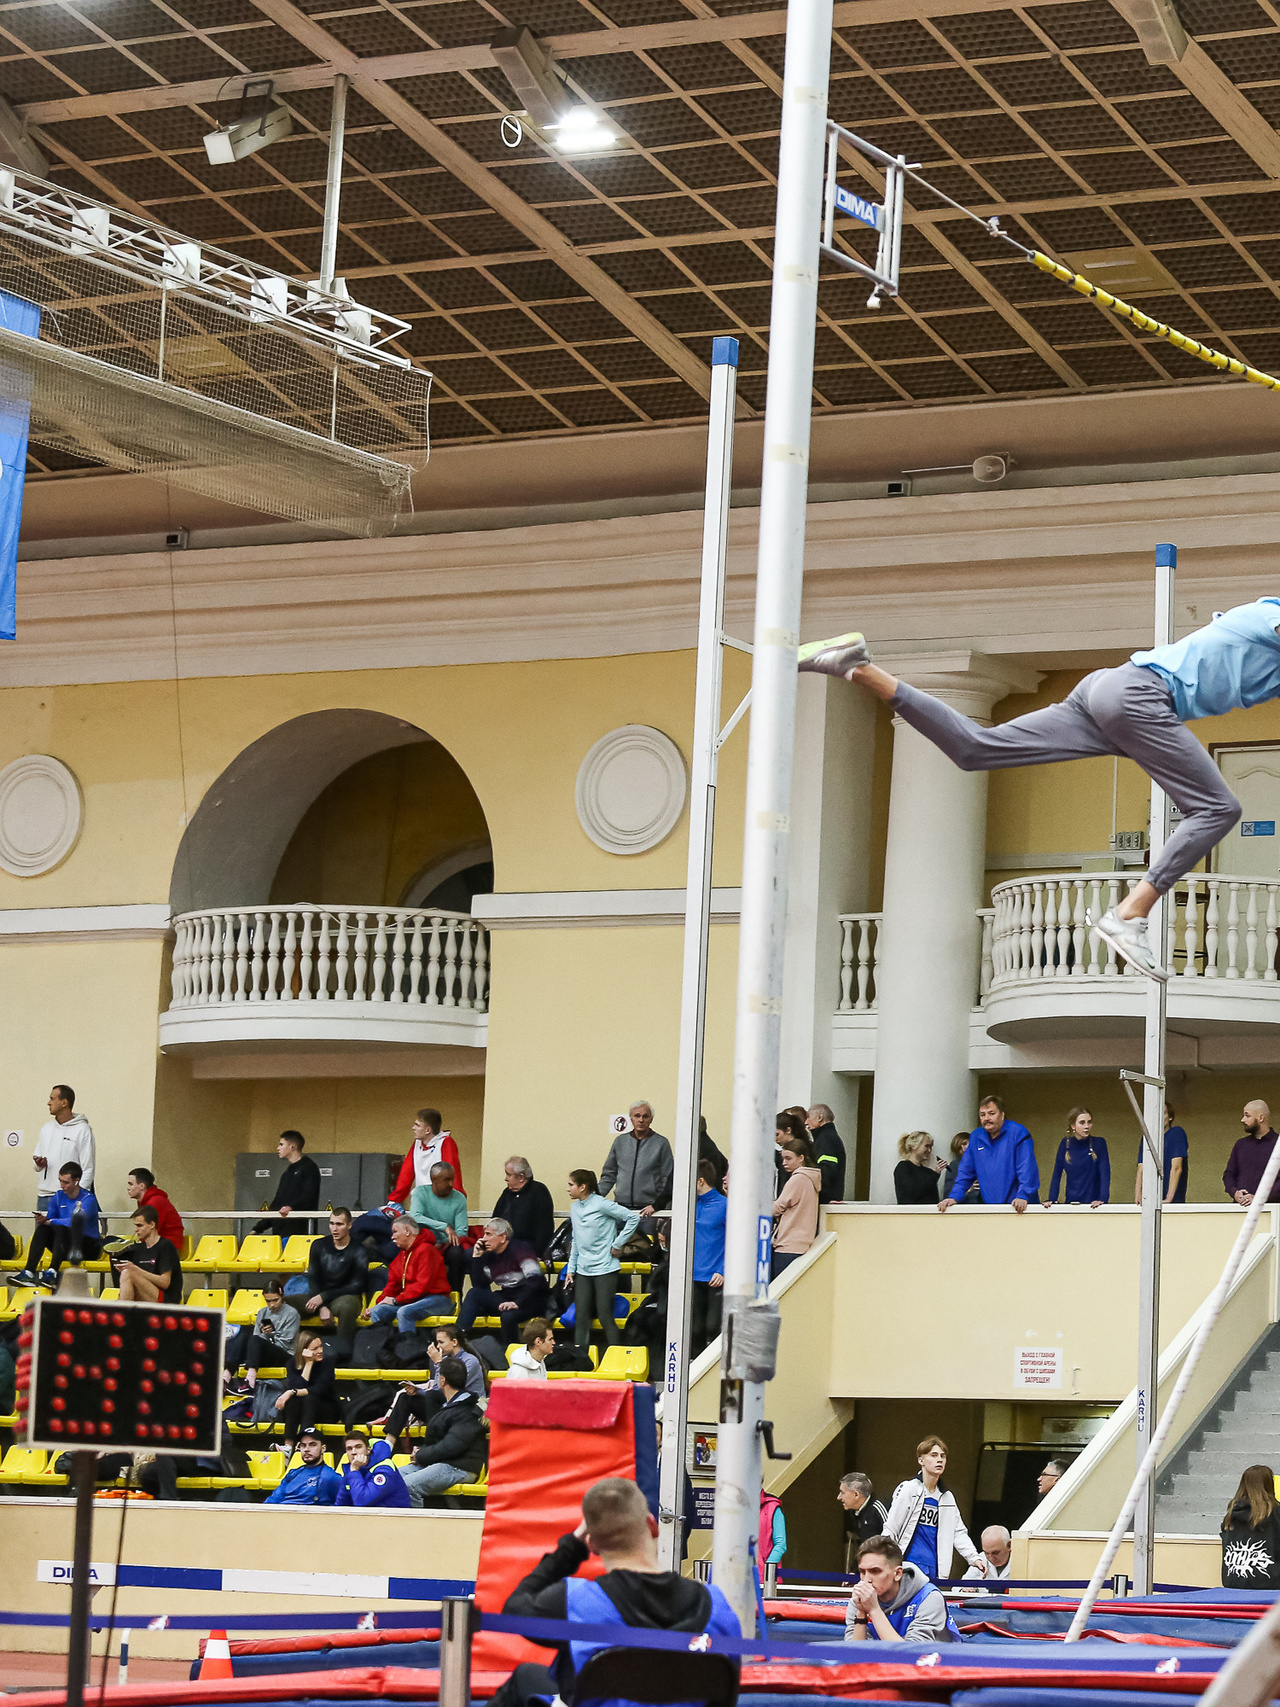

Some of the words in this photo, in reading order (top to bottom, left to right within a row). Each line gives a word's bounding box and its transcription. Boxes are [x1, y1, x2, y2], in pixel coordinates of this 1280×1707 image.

[837, 187, 875, 225] DIMA
[758, 1218, 771, 1300] DIMA
[668, 1342, 677, 1393] KARHU
[53, 1566, 98, 1580] DIA
